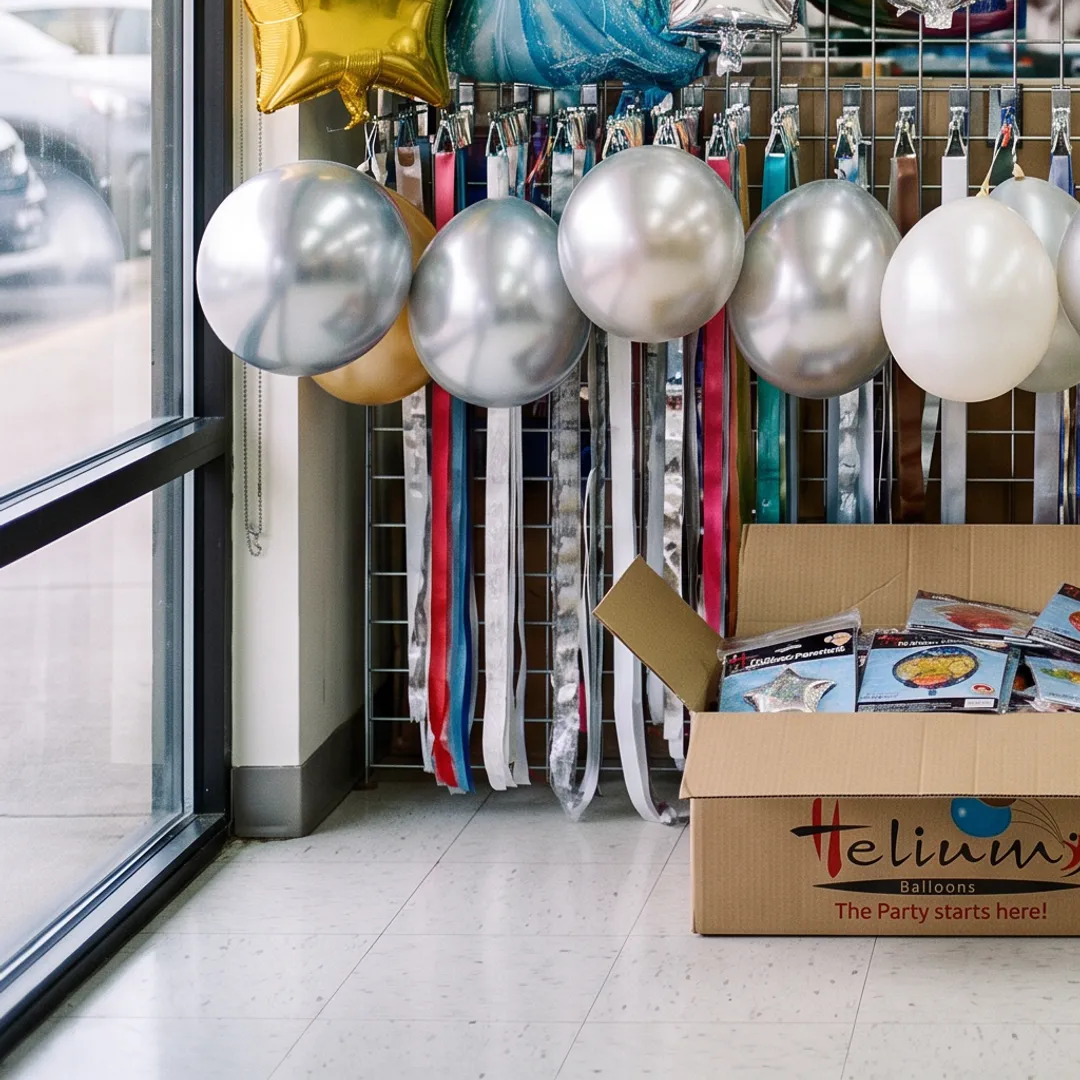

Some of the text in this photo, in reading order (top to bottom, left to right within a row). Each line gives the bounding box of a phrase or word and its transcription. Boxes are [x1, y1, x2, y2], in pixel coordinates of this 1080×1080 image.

[789, 797, 1063, 879] Helium
[899, 880, 976, 895] Balloons
[834, 902, 1048, 924] The Party starts here!
